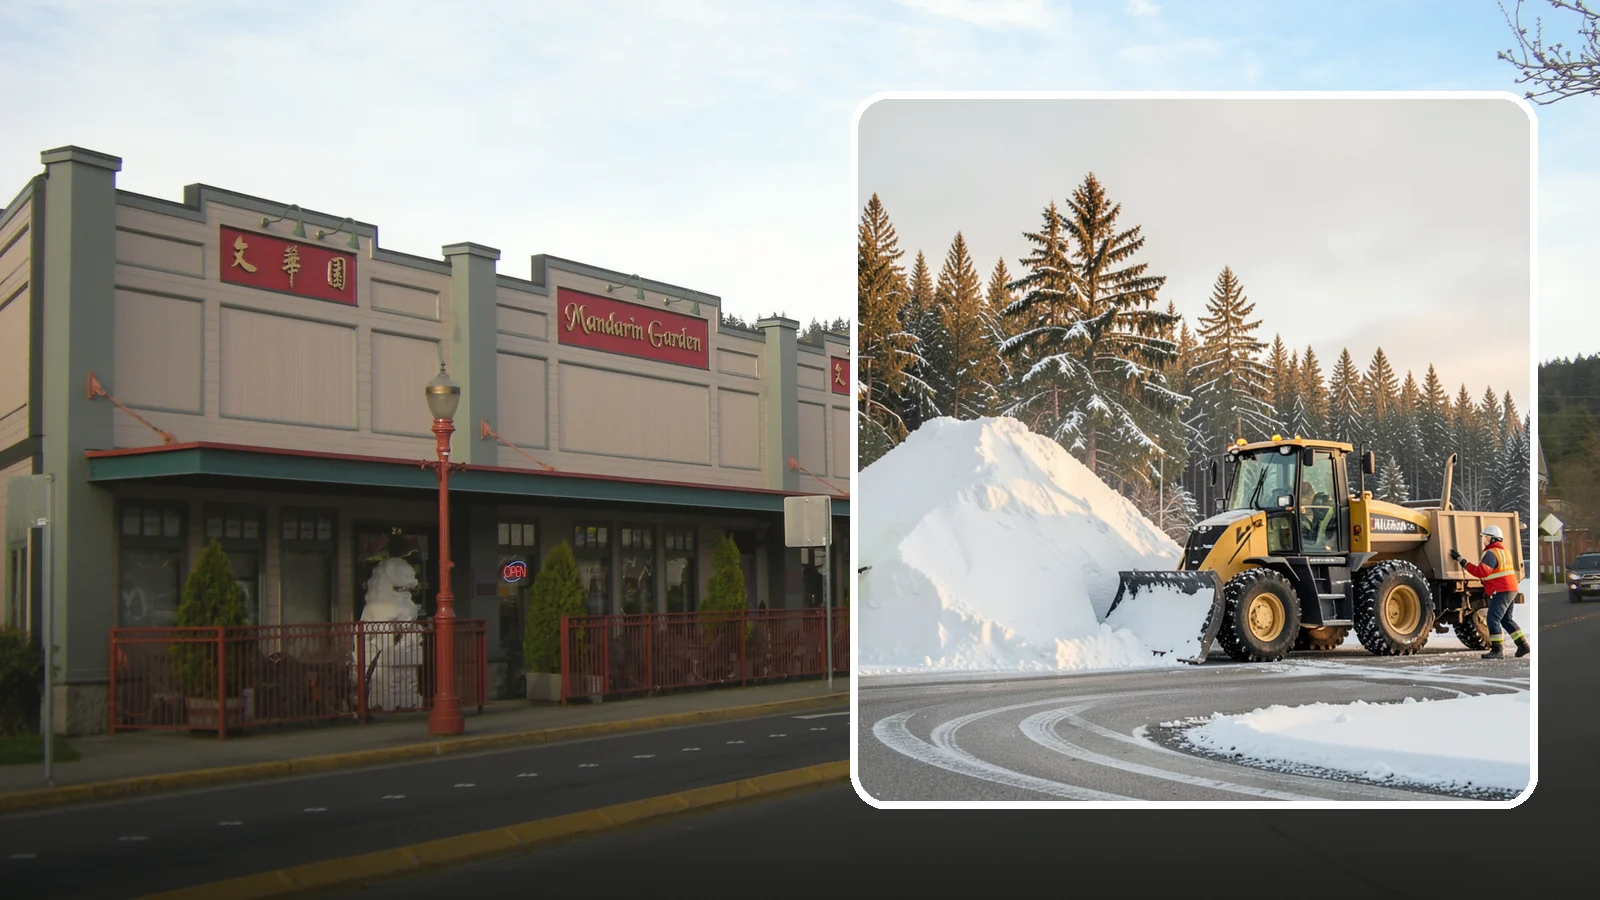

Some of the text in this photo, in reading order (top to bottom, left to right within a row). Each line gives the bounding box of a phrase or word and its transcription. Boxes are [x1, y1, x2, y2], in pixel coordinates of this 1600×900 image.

[231, 235, 346, 291] 文華園
[564, 302, 702, 352] Mandarin Garden
[503, 565, 526, 578] OPEN
